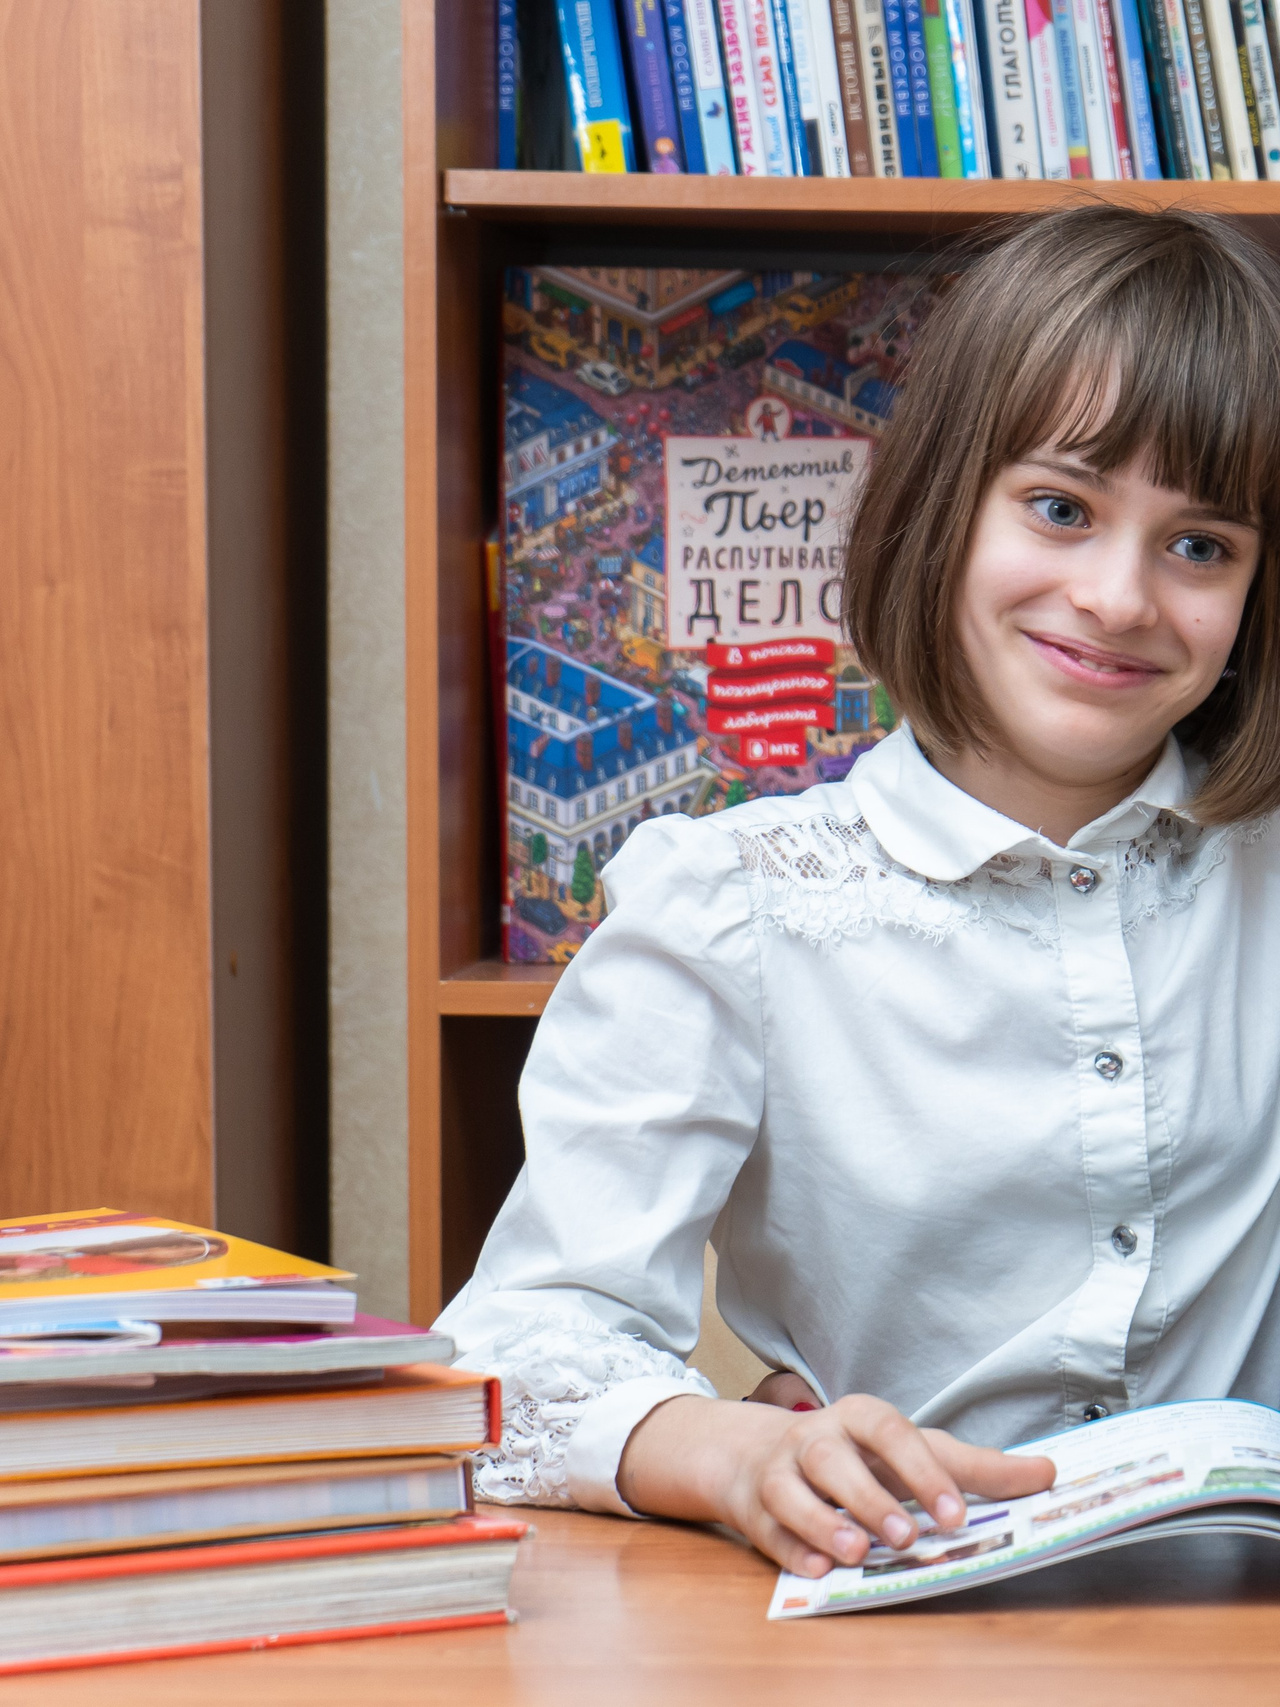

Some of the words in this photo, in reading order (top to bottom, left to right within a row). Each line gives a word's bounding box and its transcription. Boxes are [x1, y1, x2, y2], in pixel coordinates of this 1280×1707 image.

[500, 25, 514, 110] МОСКВЫ
[670, 26, 694, 111] МОСКВЫ
[759, 55, 777, 107] СЕМЬ
[840, 41, 863, 121] ИСТОРИЯ
[889, 30, 911, 116] МОСКВЫ
[909, 30, 930, 116] МОСКВЫ
[1196, 40, 1217, 110] КОЛЬЦА
[681, 449, 854, 489] Детектив
[704, 489, 826, 542] Пьер
[682, 546, 845, 570] РАСПУТЫВАЕ
[726, 647, 743, 665] В
[748, 643, 817, 662] поисках
[712, 674, 829, 697] похищенного
[722, 708, 818, 729] лабиринта
[769, 743, 800, 756] МТС
